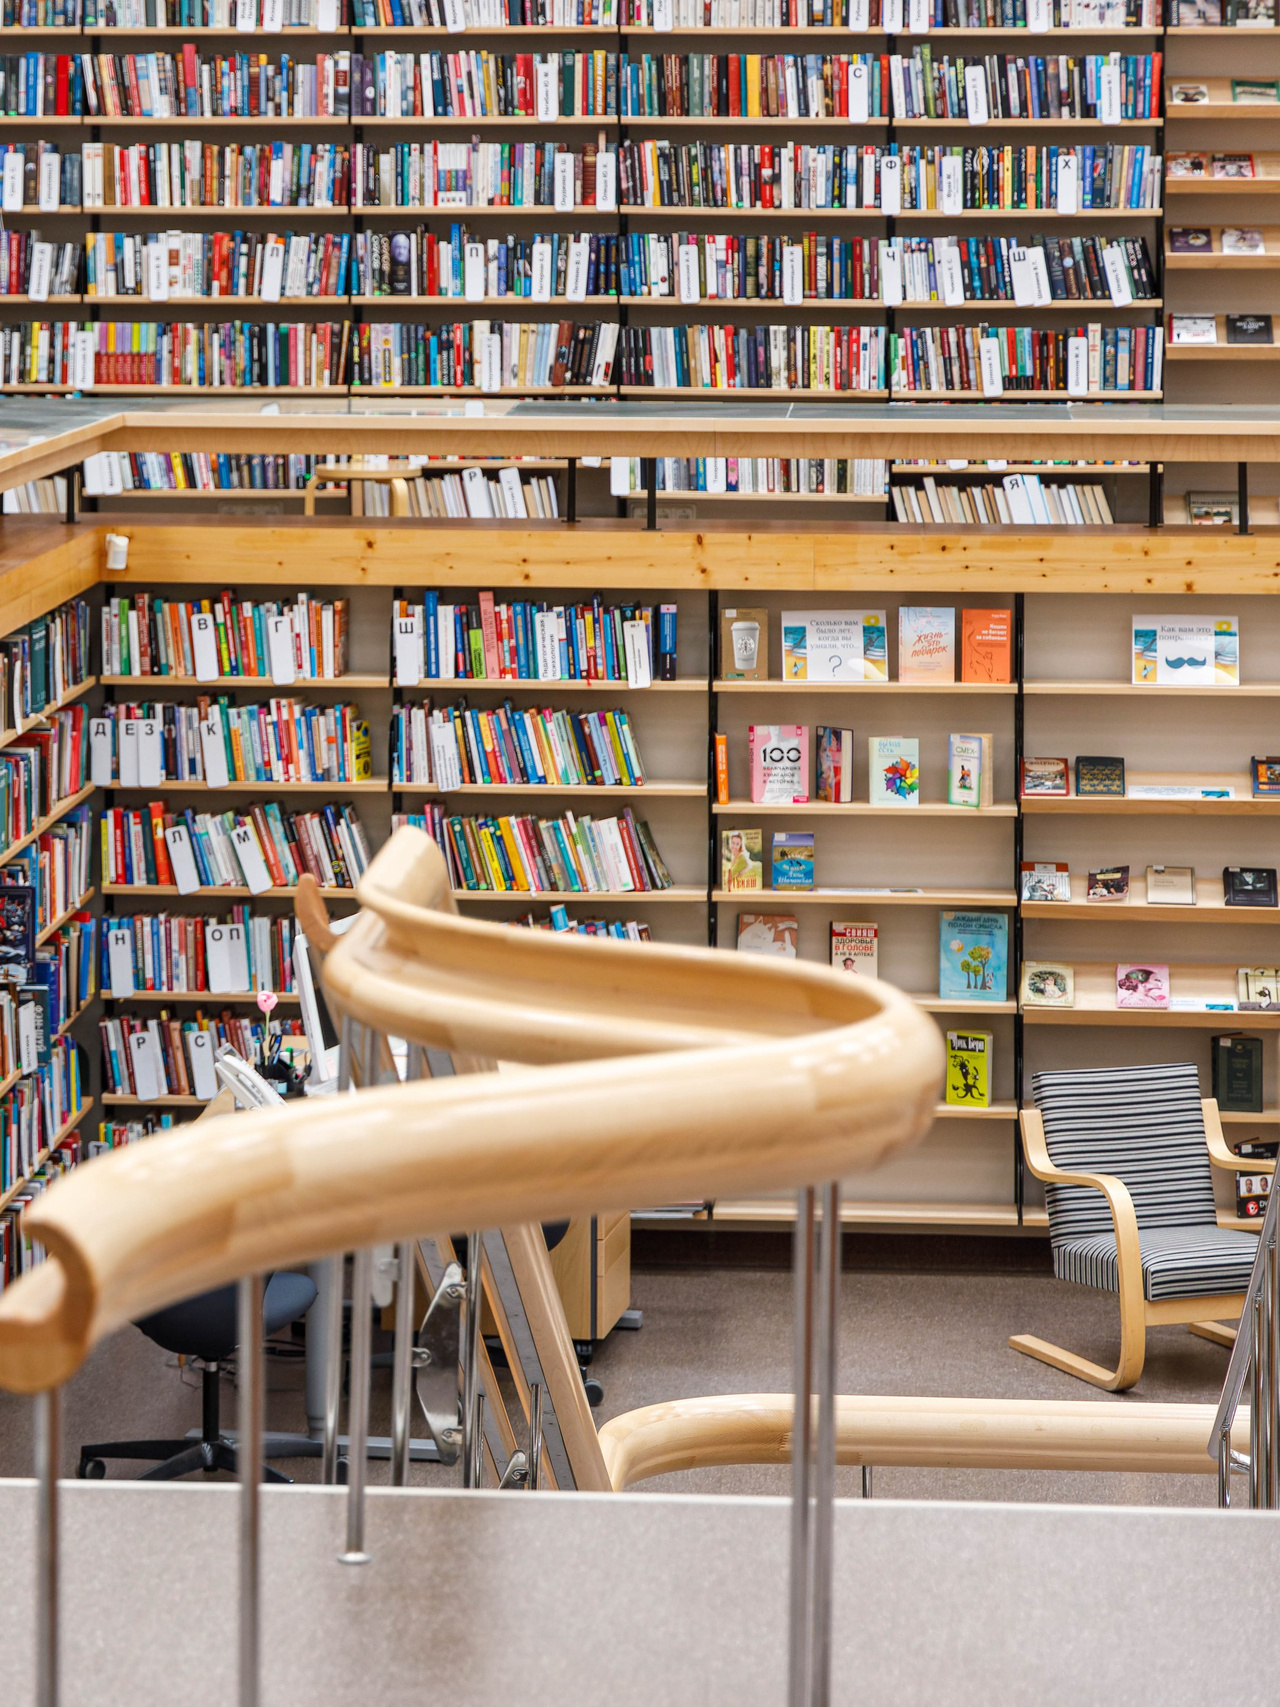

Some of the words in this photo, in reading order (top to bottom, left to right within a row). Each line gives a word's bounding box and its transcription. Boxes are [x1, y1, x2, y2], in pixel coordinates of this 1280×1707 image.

[853, 68, 862, 78] С
[886, 160, 897, 170] Ф
[1063, 159, 1071, 169] Х
[470, 247, 479, 258] П
[887, 251, 895, 262] Ч
[469, 470, 477, 482] Р
[1010, 479, 1019, 490] Я
[198, 618, 208, 630] В
[274, 620, 283, 633] Г
[400, 622, 413, 634] Ш
[810, 619, 843, 627] Сколько
[816, 626, 836, 634] было
[95, 722, 106, 737] Д
[125, 723, 135, 736] Е
[145, 723, 154, 735] З
[206, 723, 216, 736] К
[762, 747, 801, 763] 100
[172, 830, 183, 843] Л
[236, 830, 250, 844] М
[212, 929, 223, 941] О
[230, 928, 240, 940] П
[846, 928, 875, 937] СВИЯШ
[115, 934, 126, 945] Н
[136, 1037, 146, 1049] Р
[195, 1035, 205, 1048] С
